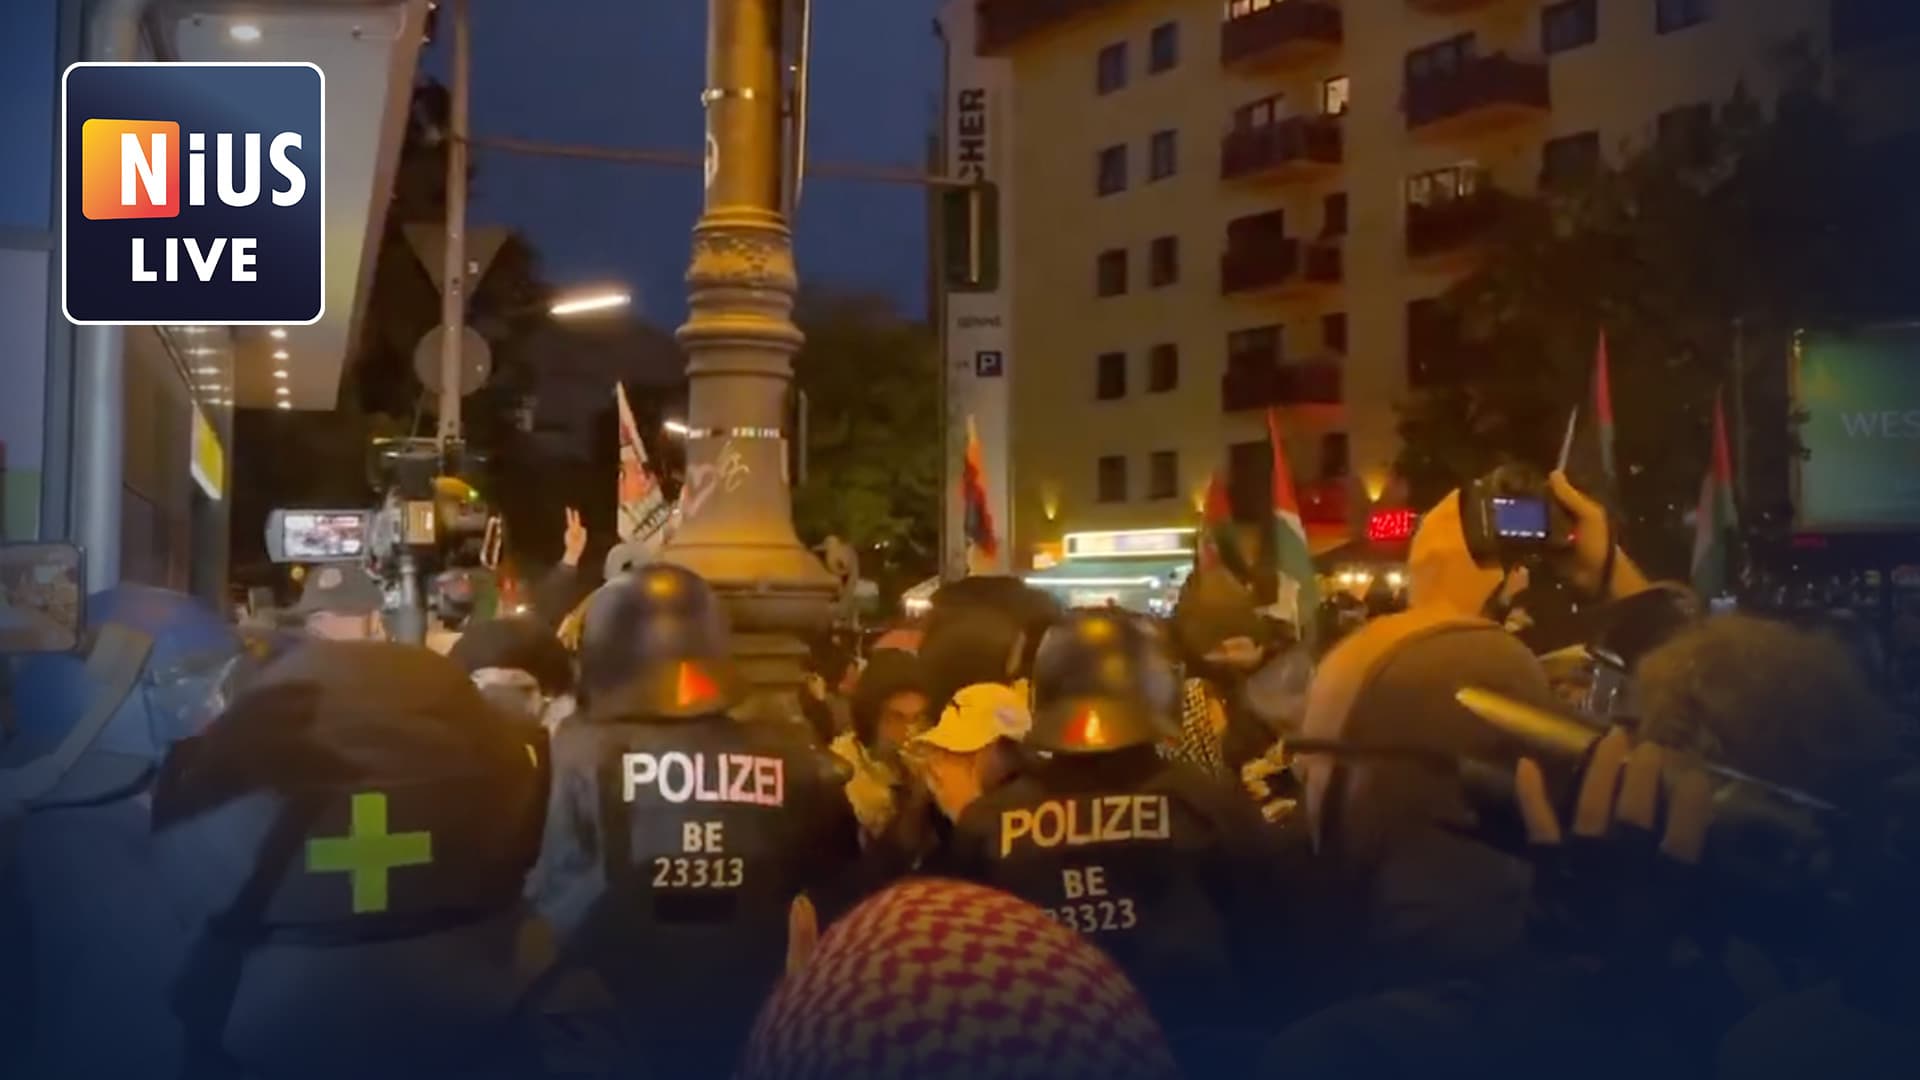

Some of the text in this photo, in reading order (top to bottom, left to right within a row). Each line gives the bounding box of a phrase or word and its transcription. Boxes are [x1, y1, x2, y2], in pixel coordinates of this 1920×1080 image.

[622, 752, 784, 807] POLIZEI
[683, 821, 723, 853] BE
[1001, 795, 1170, 859] POLIZEI
[653, 857, 744, 888] 23313
[1063, 866, 1108, 898] BE
